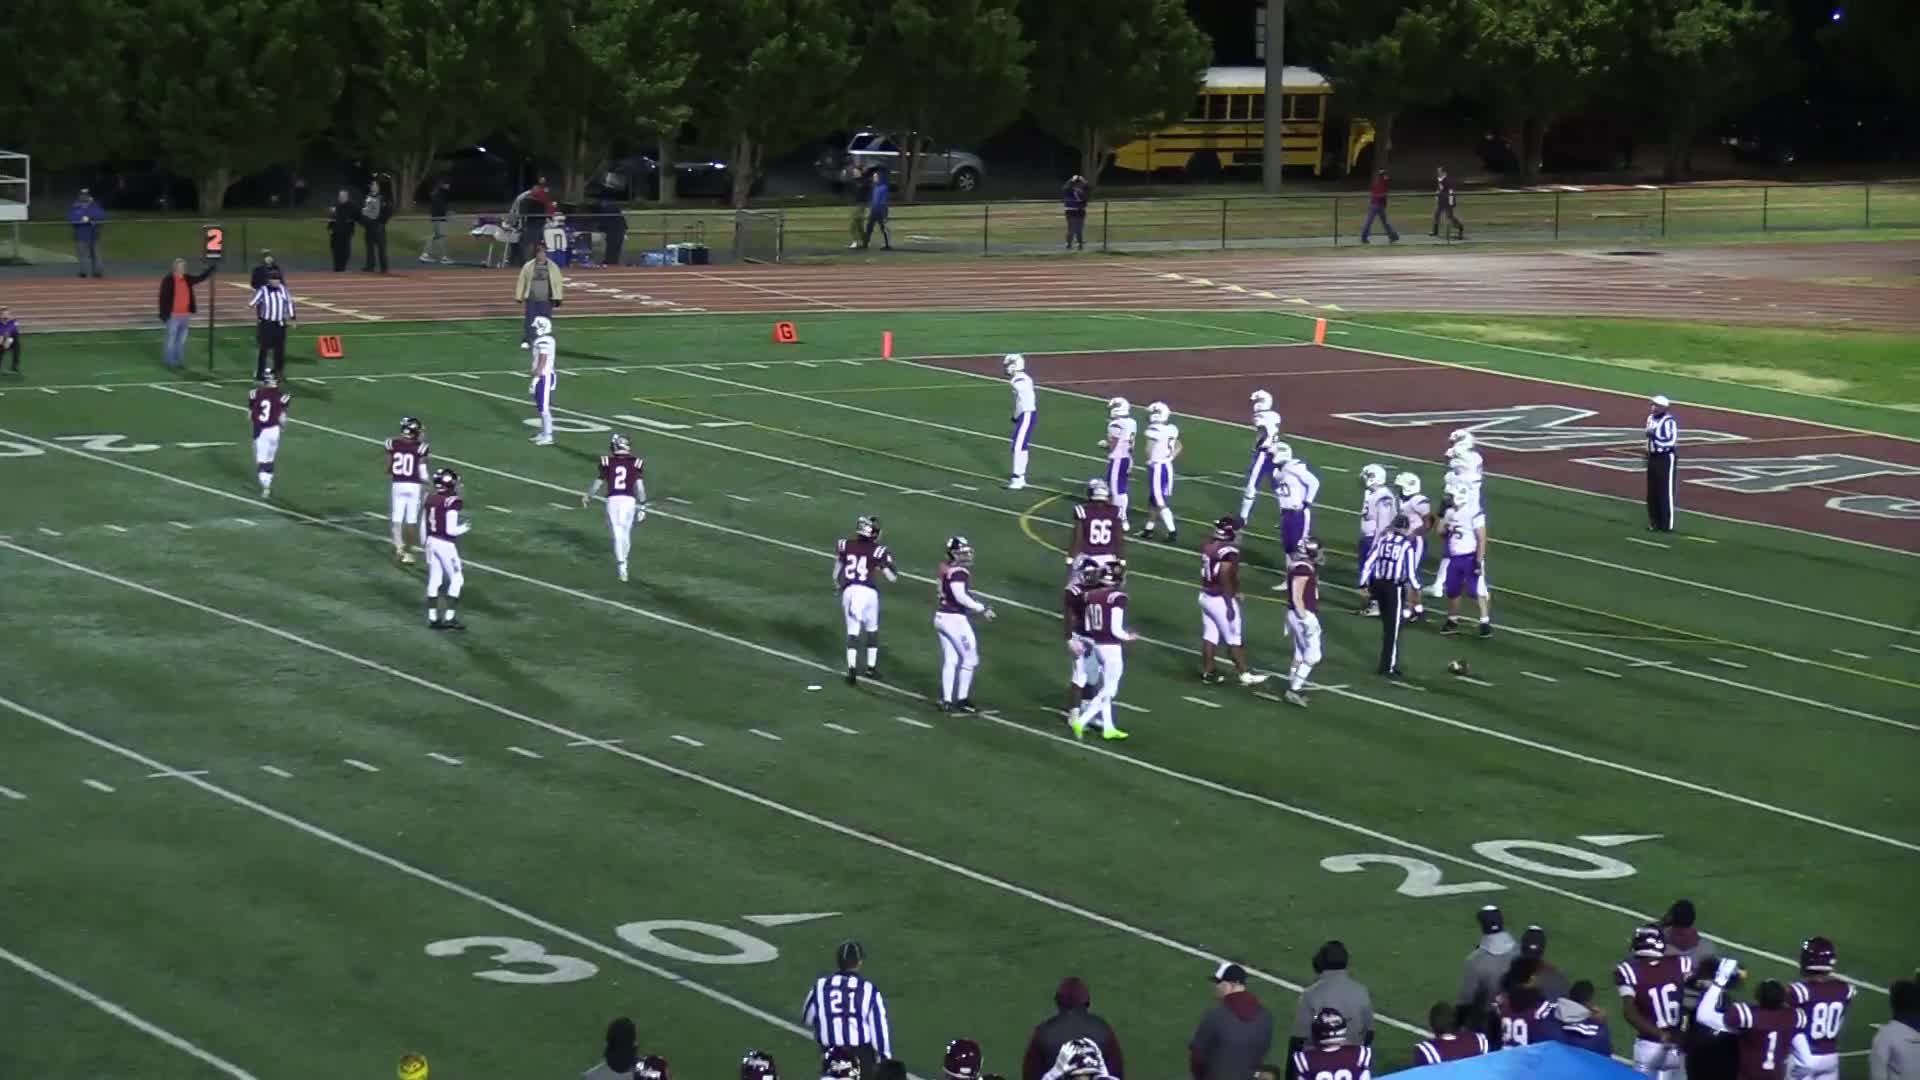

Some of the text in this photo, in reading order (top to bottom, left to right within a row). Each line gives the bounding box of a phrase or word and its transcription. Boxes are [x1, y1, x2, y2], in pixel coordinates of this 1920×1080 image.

[206, 228, 222, 250] 2
[778, 324, 791, 339] G
[322, 338, 339, 354] 10
[257, 400, 270, 422] 3
[391, 452, 413, 476] 20
[613, 466, 626, 490] 2
[1087, 519, 1111, 544] 66
[843, 554, 867, 581] 24
[1320, 839, 1639, 898] 20
[424, 918, 780, 984] 30
[828, 989, 855, 1013] 21
[1646, 983, 1677, 1028] 16
[1810, 1002, 1842, 1039] 80
[1760, 1031, 1776, 1069] 1
